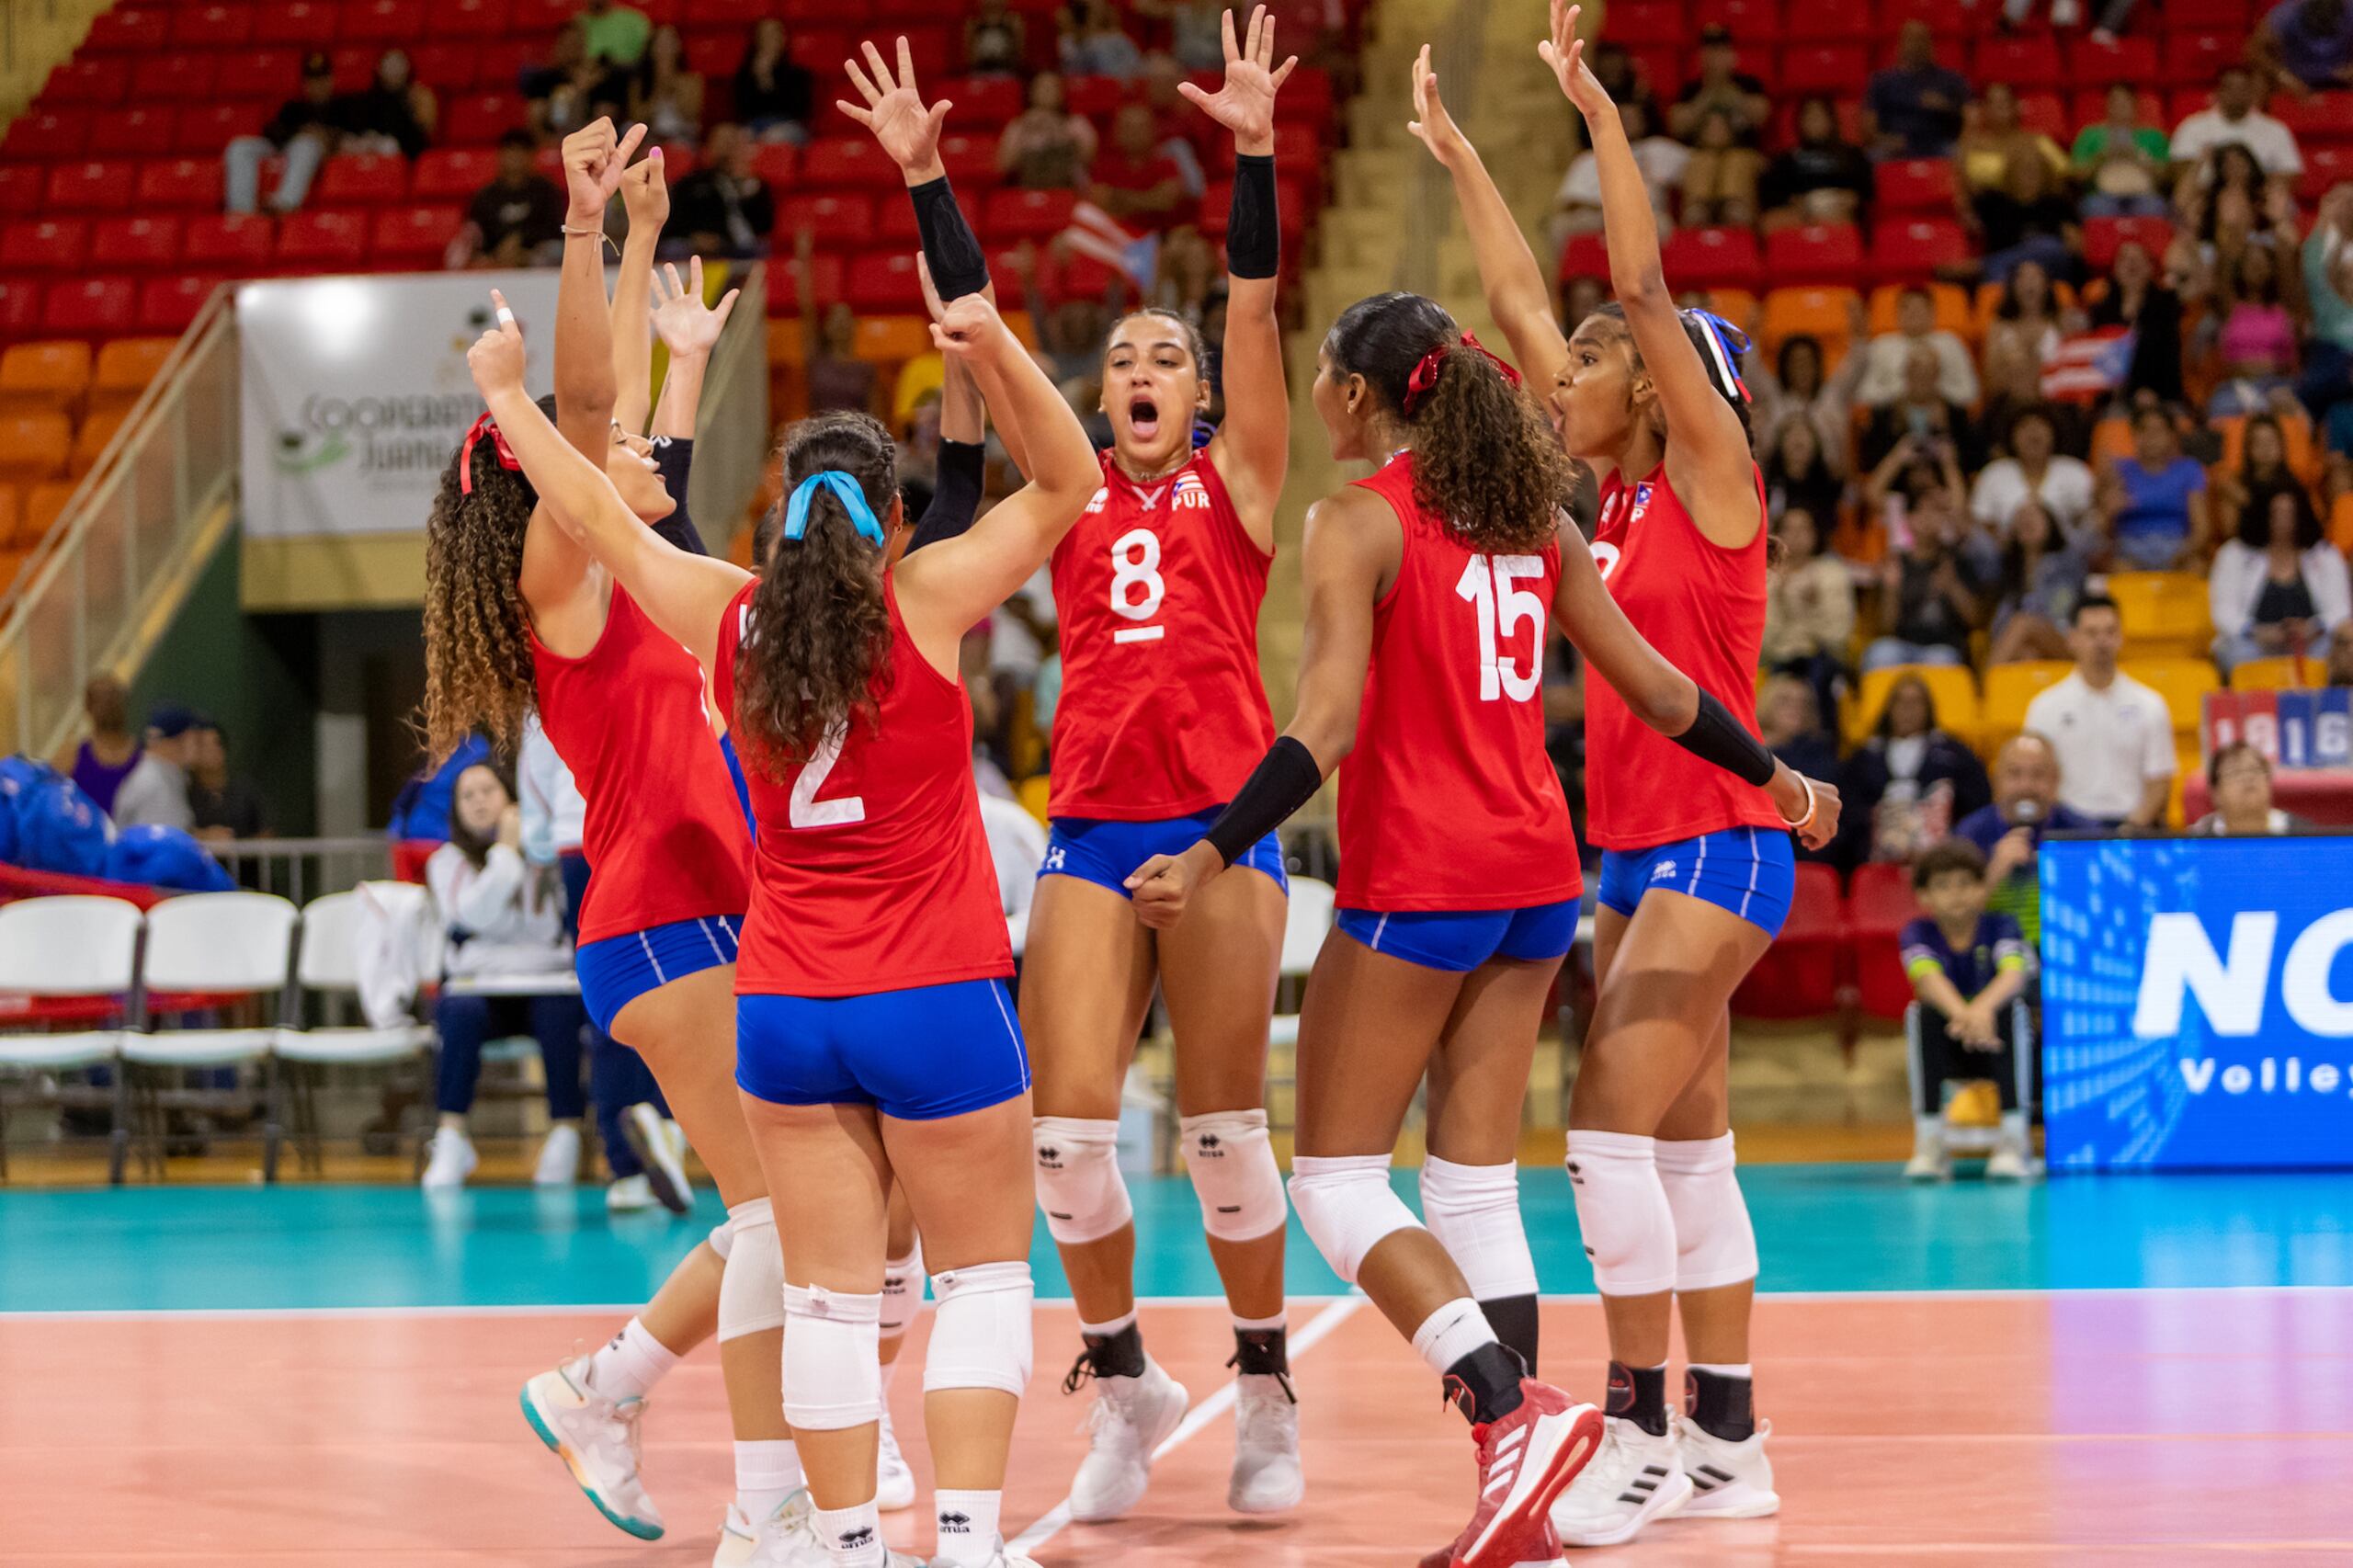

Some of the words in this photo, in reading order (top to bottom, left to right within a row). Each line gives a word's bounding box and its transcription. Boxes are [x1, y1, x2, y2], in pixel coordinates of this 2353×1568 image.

[1171, 492, 1211, 512] PUR
[1109, 528, 1166, 621] 8
[1454, 552, 1546, 703] 15
[789, 676, 866, 829] 2
[2179, 1056, 2353, 1099] Volle
